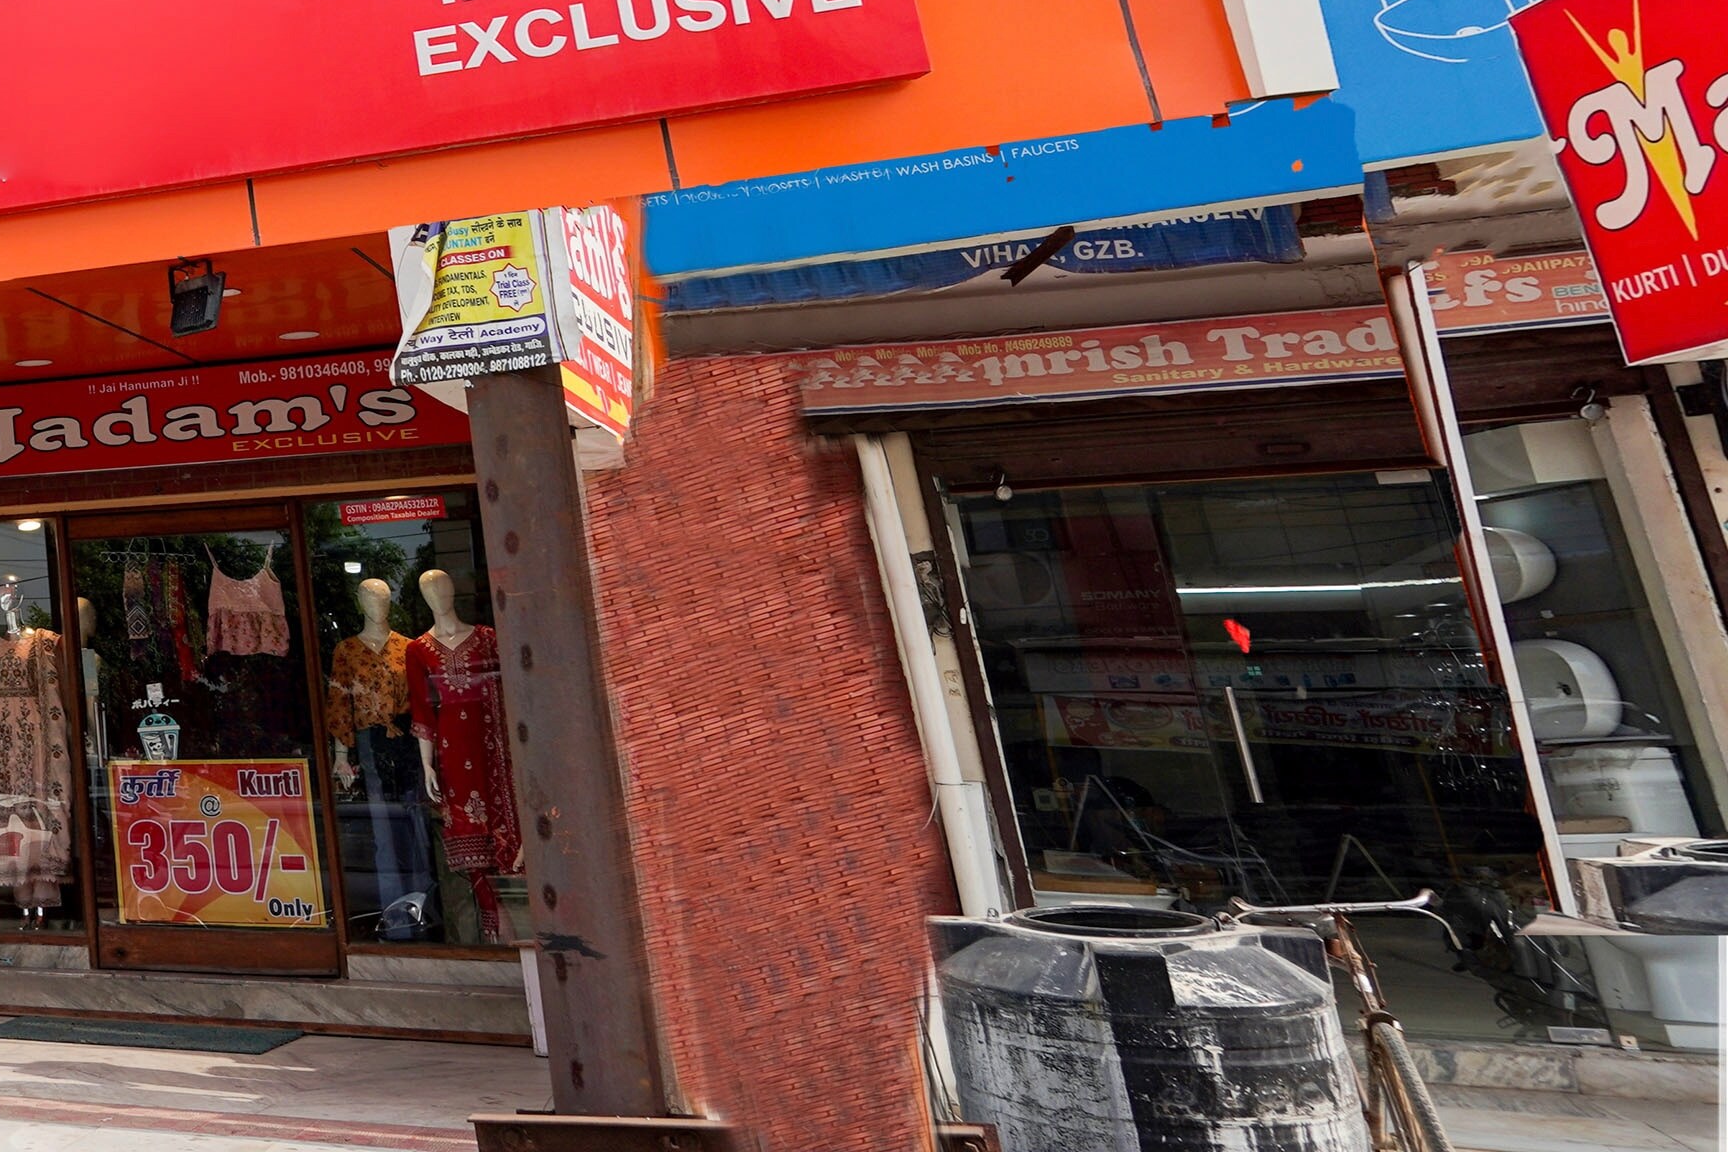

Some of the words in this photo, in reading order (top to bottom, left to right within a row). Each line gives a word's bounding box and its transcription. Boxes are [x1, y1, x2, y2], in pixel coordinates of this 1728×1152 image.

[895, 160, 940, 177] WASH
[943, 152, 994, 171] BASINS
[1011, 138, 1080, 159] FAUCETS
[440, 252, 486, 267] CLASSES
[488, 249, 505, 259] ON
[1073, 237, 1144, 262] GZB.
[496, 280, 511, 289] Trial
[512, 278, 530, 288] Class
[499, 289, 517, 299] FREE
[1611, 264, 1680, 303] KURTI
[420, 334, 444, 345] Way
[480, 322, 540, 338] Academy
[1113, 366, 1223, 385] Sanitary
[1231, 362, 1253, 377] &
[1263, 355, 1400, 375] Hardware
[99, 382, 116, 394] Jai
[119, 378, 175, 392] Hanuman
[232, 428, 420, 451] EXCLUSIVE
[1081, 588, 1161, 601] SOMANY
[238, 769, 302, 797] Kurti
[200, 795, 222, 817] @
[128, 818, 306, 902] 350/-
[268, 898, 313, 922] Only
